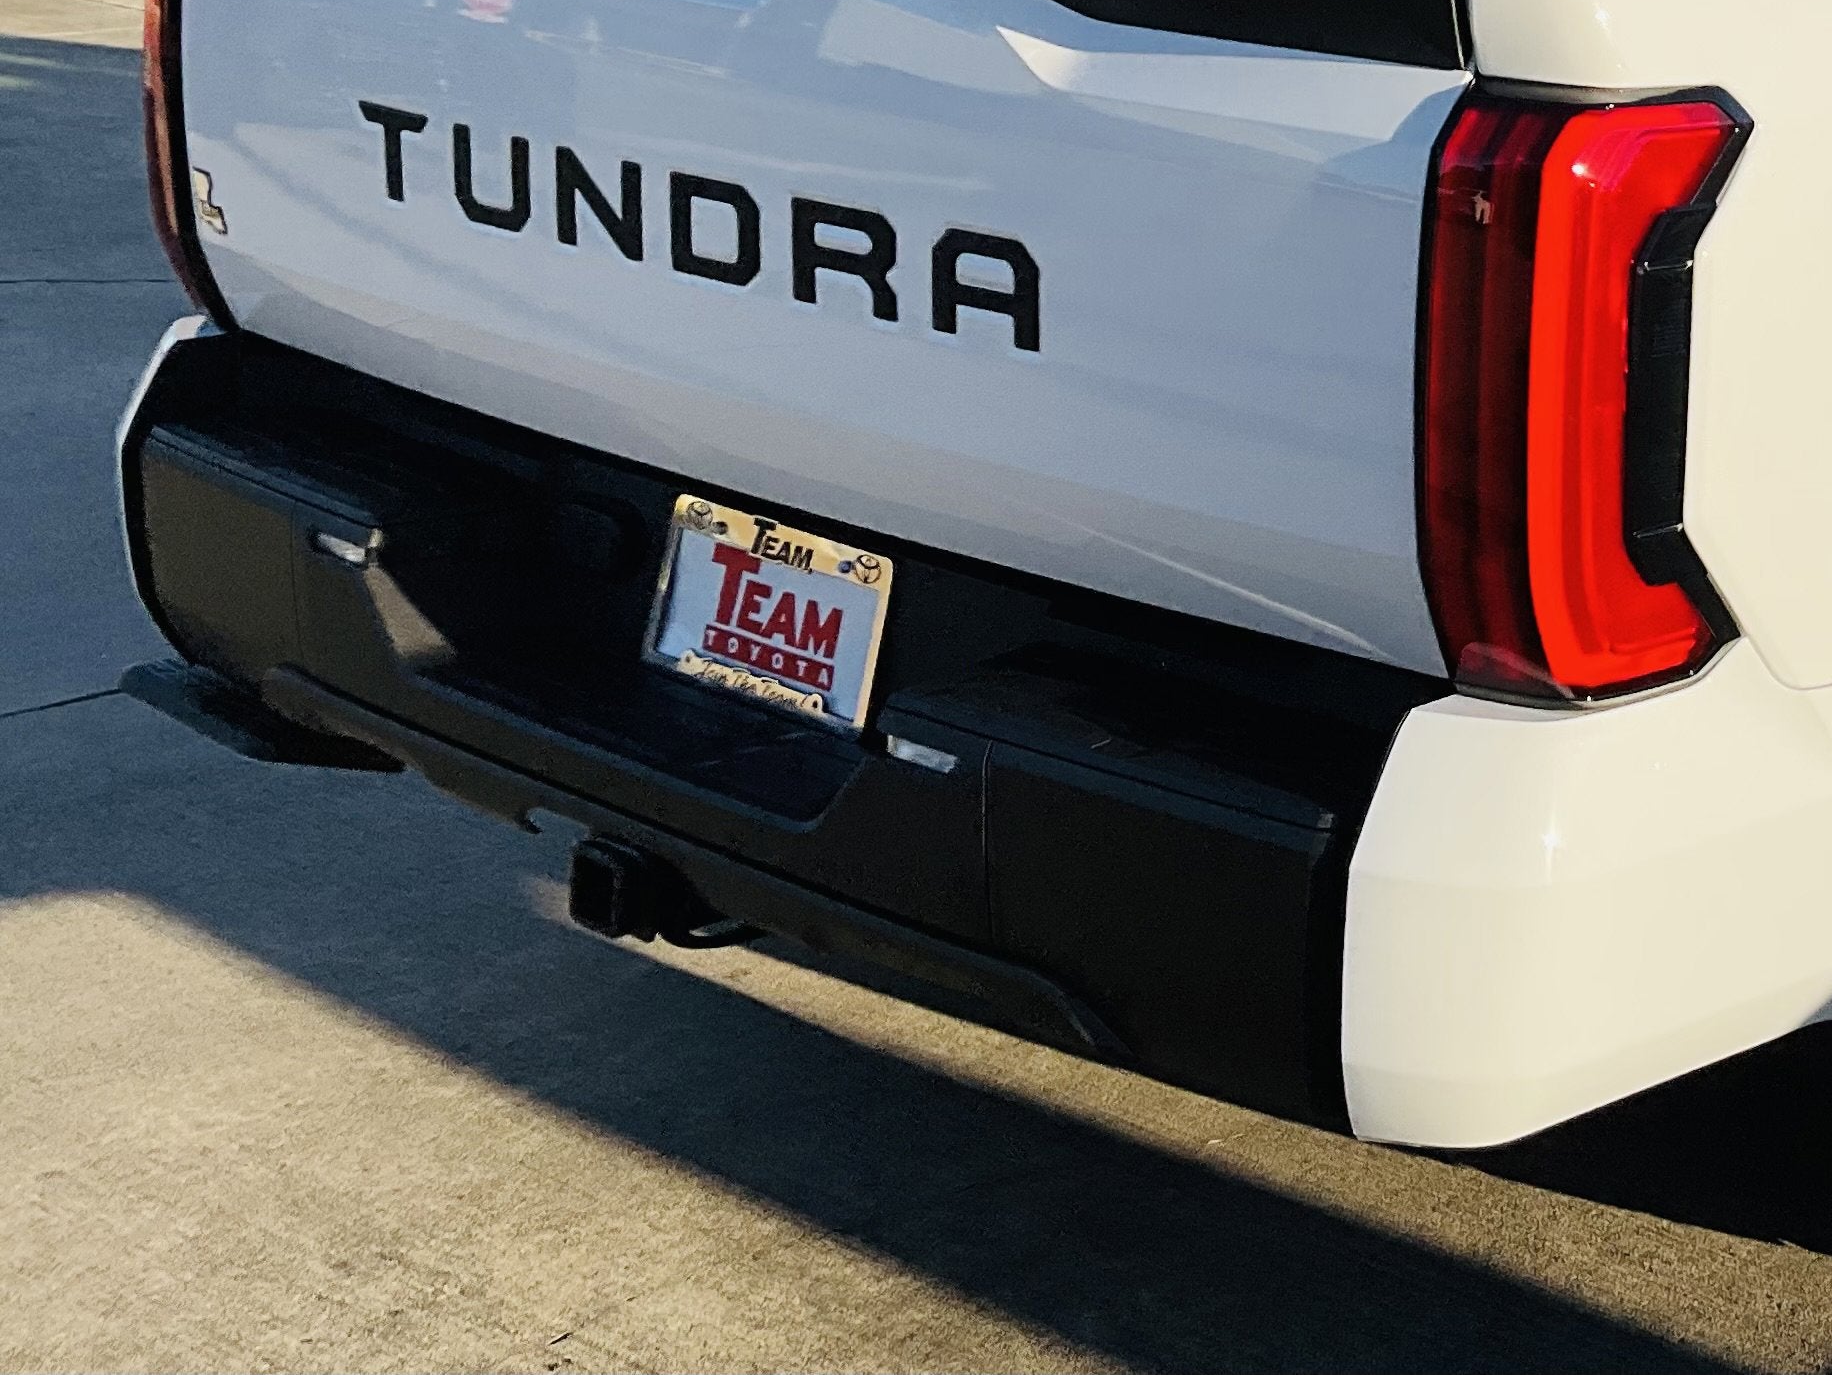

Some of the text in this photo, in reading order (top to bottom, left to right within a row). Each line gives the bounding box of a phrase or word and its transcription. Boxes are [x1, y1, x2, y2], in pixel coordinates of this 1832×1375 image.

[358, 99, 1041, 353] TUNDRA
[705, 629, 831, 684] TOYOTA
[712, 541, 843, 659] TEAM
